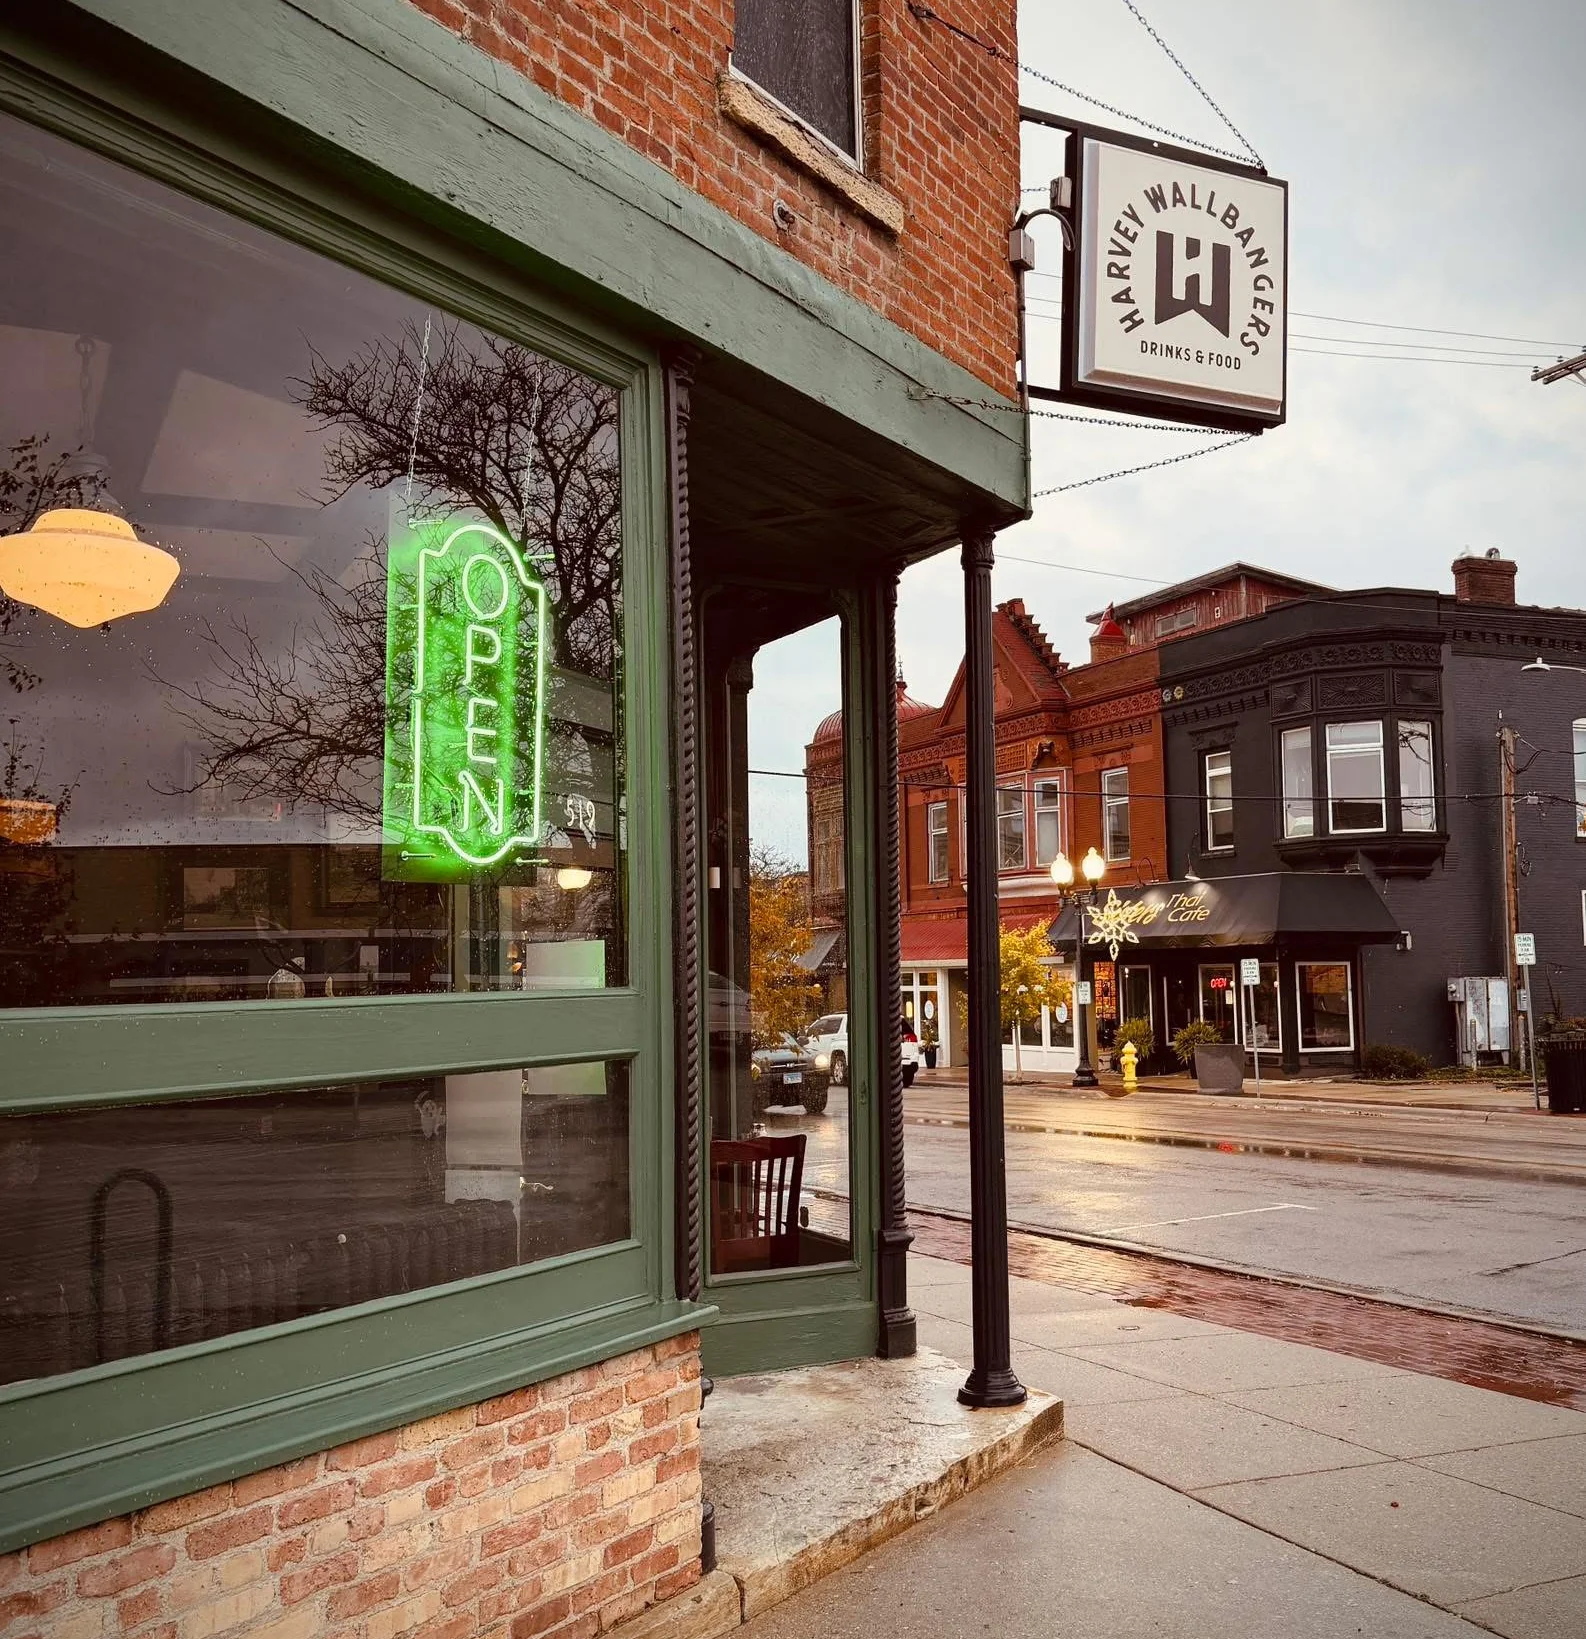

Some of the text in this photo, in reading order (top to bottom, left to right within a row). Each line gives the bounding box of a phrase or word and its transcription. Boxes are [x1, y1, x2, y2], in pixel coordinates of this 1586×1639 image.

[1106, 181, 1275, 356] HARVEY WALLBANGERS
[1140, 340, 1241, 370] DRINKS & FOOD
[459, 553, 508, 835] OPEN
[1166, 890, 1205, 908] Thai
[1167, 905, 1210, 922] Cafe
